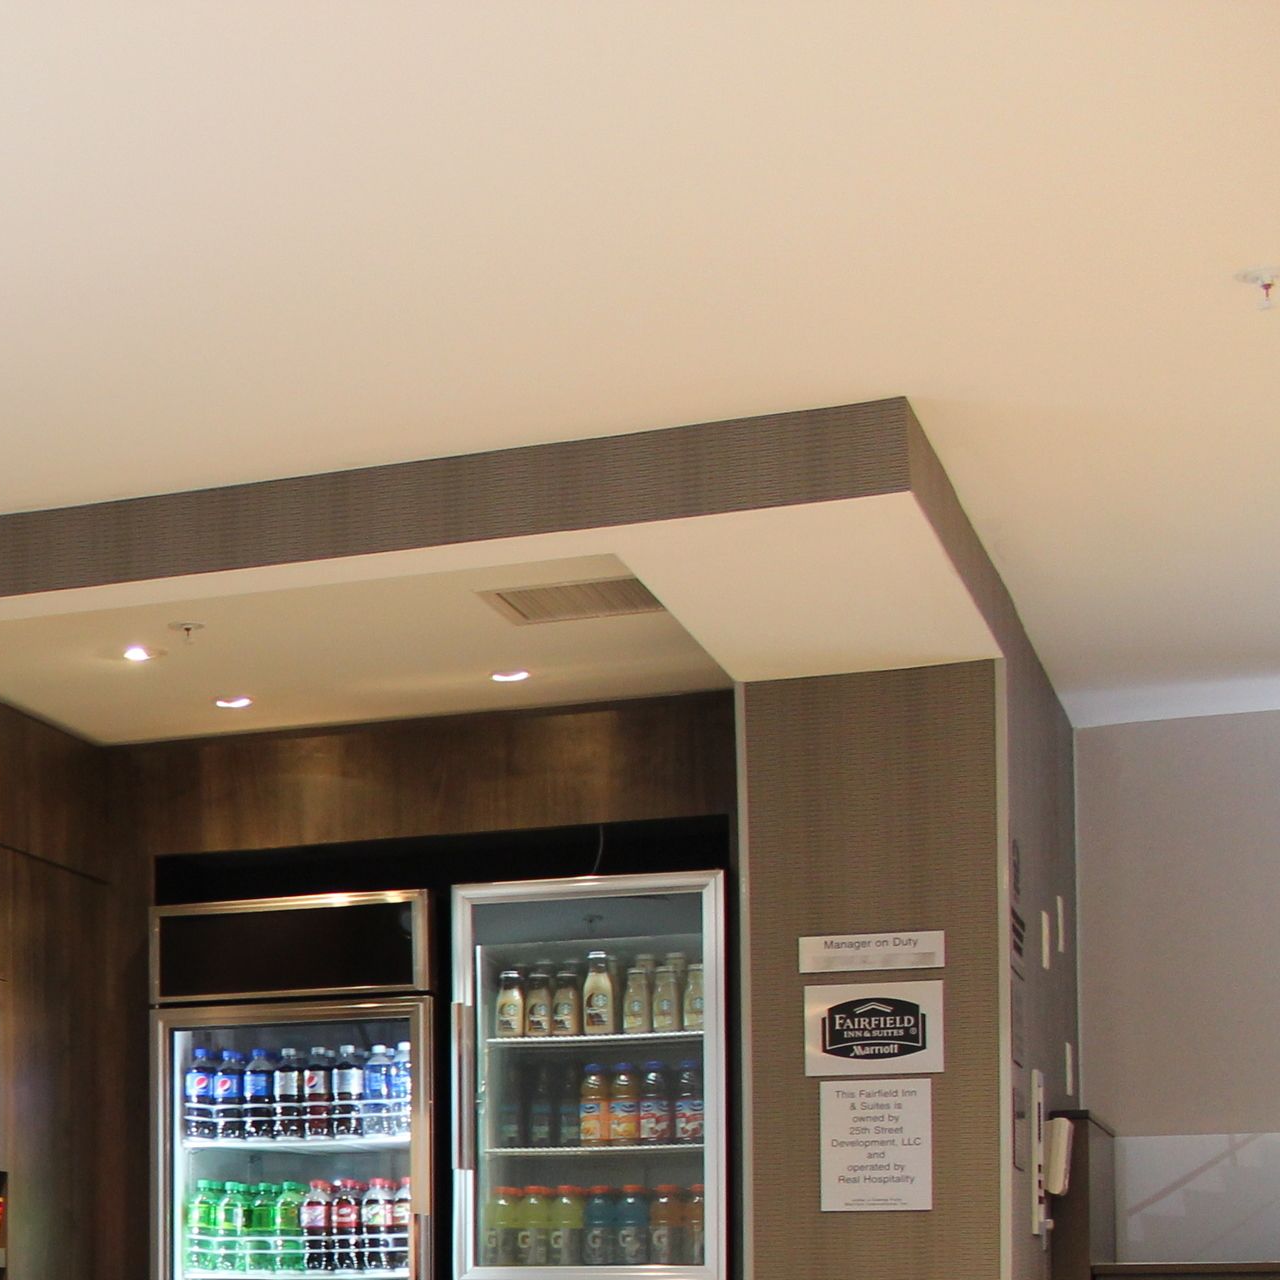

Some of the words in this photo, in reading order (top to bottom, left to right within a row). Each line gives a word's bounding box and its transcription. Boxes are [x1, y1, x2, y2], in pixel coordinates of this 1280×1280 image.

[823, 940, 871, 951] Manager
[874, 940, 889, 948] on
[892, 937, 919, 949] Duty
[834, 1014, 915, 1030] FAIRFIELD
[850, 1044, 899, 1057] Marriott
[835, 1090, 855, 1099] This
[858, 1089, 899, 1099] Fairfield
[901, 1089, 917, 1098] Inn
[849, 1102, 857, 1111] &
[860, 1102, 891, 1111] Suites
[894, 1102, 903, 1110] is
[852, 1114, 885, 1123] owned
[887, 1114, 900, 1124] by
[849, 1126, 871, 1135] 25th
[873, 1126, 904, 1135] Street
[901, 1137, 922, 1147] LLC
[866, 1151, 886, 1159] and
[847, 1163, 891, 1173] operated
[893, 1162, 906, 1173] by
[838, 1175, 860, 1184] Real
[863, 1174, 915, 1185] Hospitality
